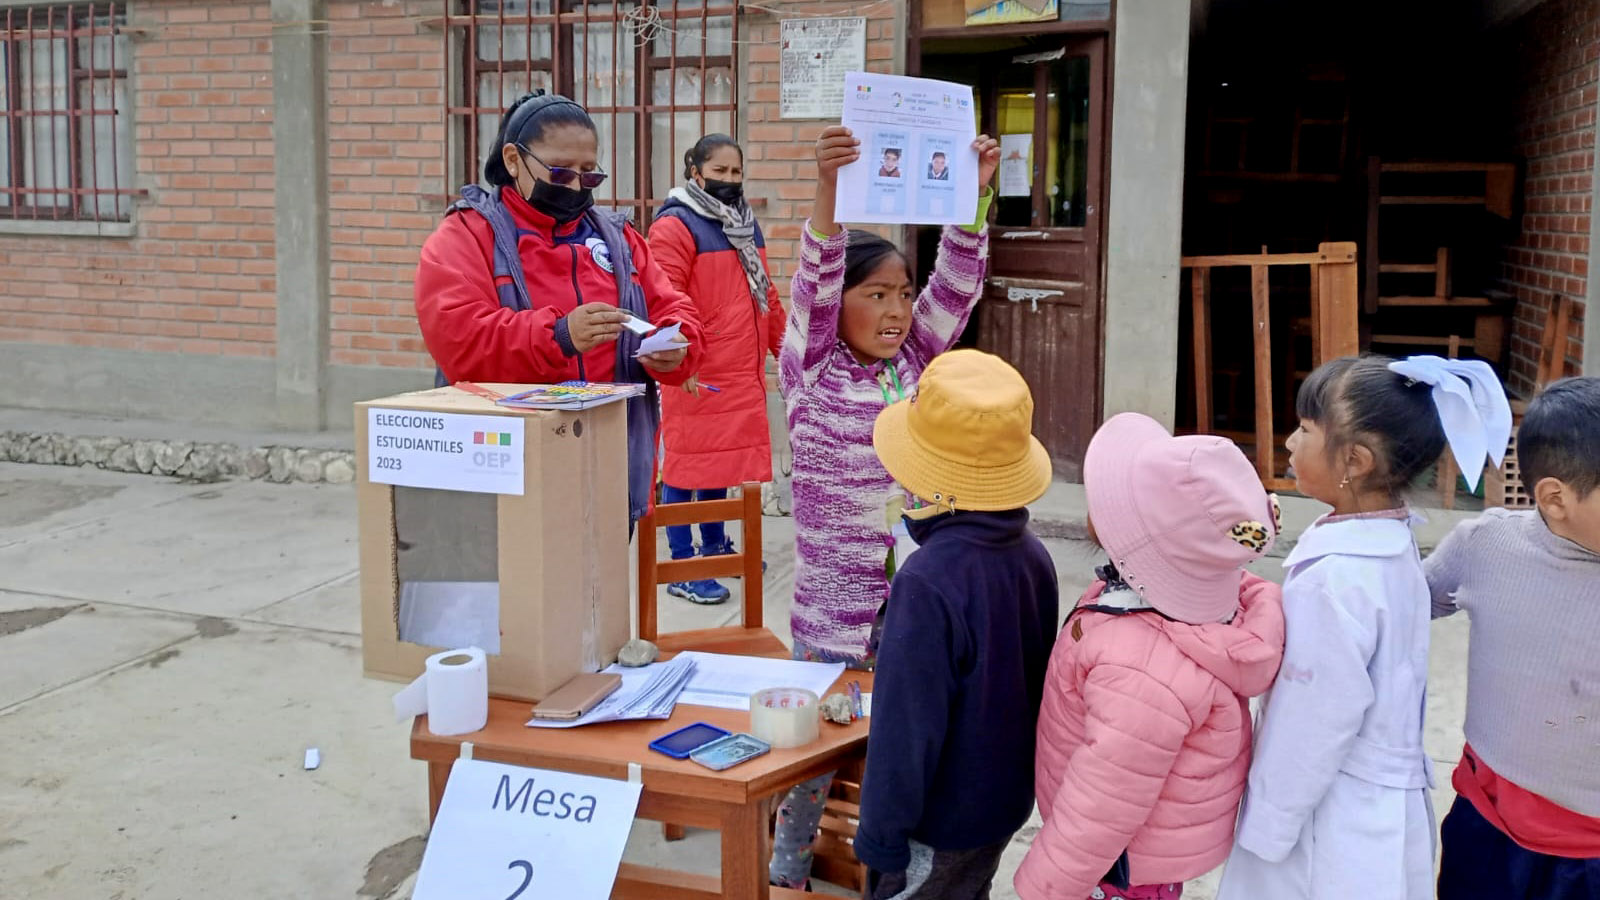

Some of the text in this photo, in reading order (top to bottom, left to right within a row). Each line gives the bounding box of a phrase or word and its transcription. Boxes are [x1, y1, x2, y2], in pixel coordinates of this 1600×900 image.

[376, 414, 444, 430] ELECCIONES
[376, 435, 463, 454] ESTUDIANTILES
[376, 456, 402, 470] 2023
[472, 451, 511, 468] OEP
[492, 774, 597, 823] Mesa
[504, 859, 534, 900] 2
